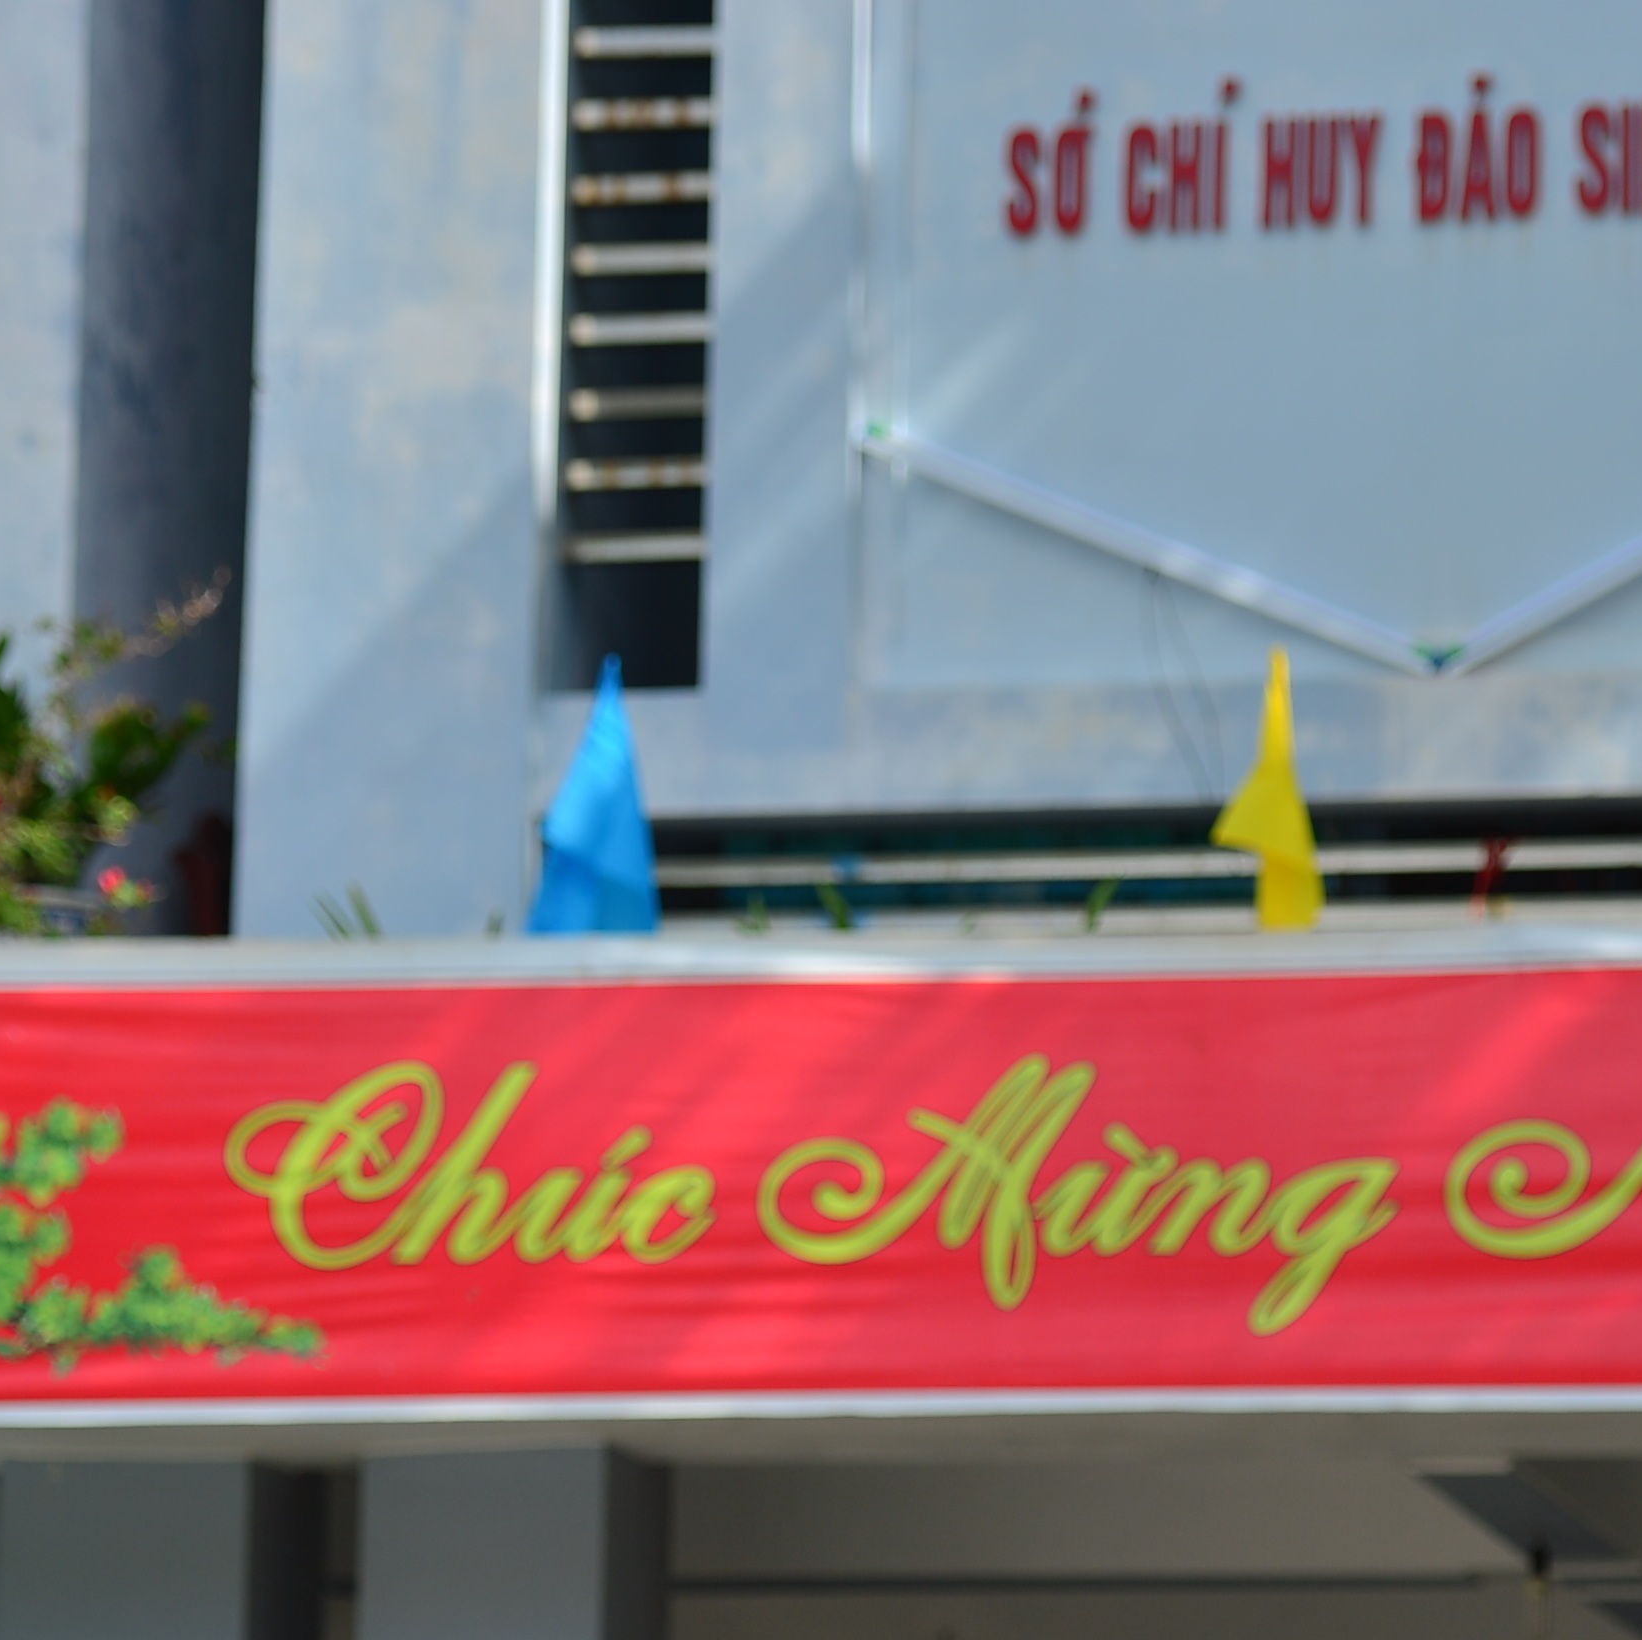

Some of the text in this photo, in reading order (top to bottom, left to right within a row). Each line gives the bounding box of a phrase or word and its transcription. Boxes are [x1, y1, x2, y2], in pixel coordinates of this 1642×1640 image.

[1262, 112, 1381, 230] HUY
[1416, 70, 1541, 226] ĐẢO
[223, 1058, 717, 1272] Chúc
[758, 1051, 1400, 1338] Mừng
